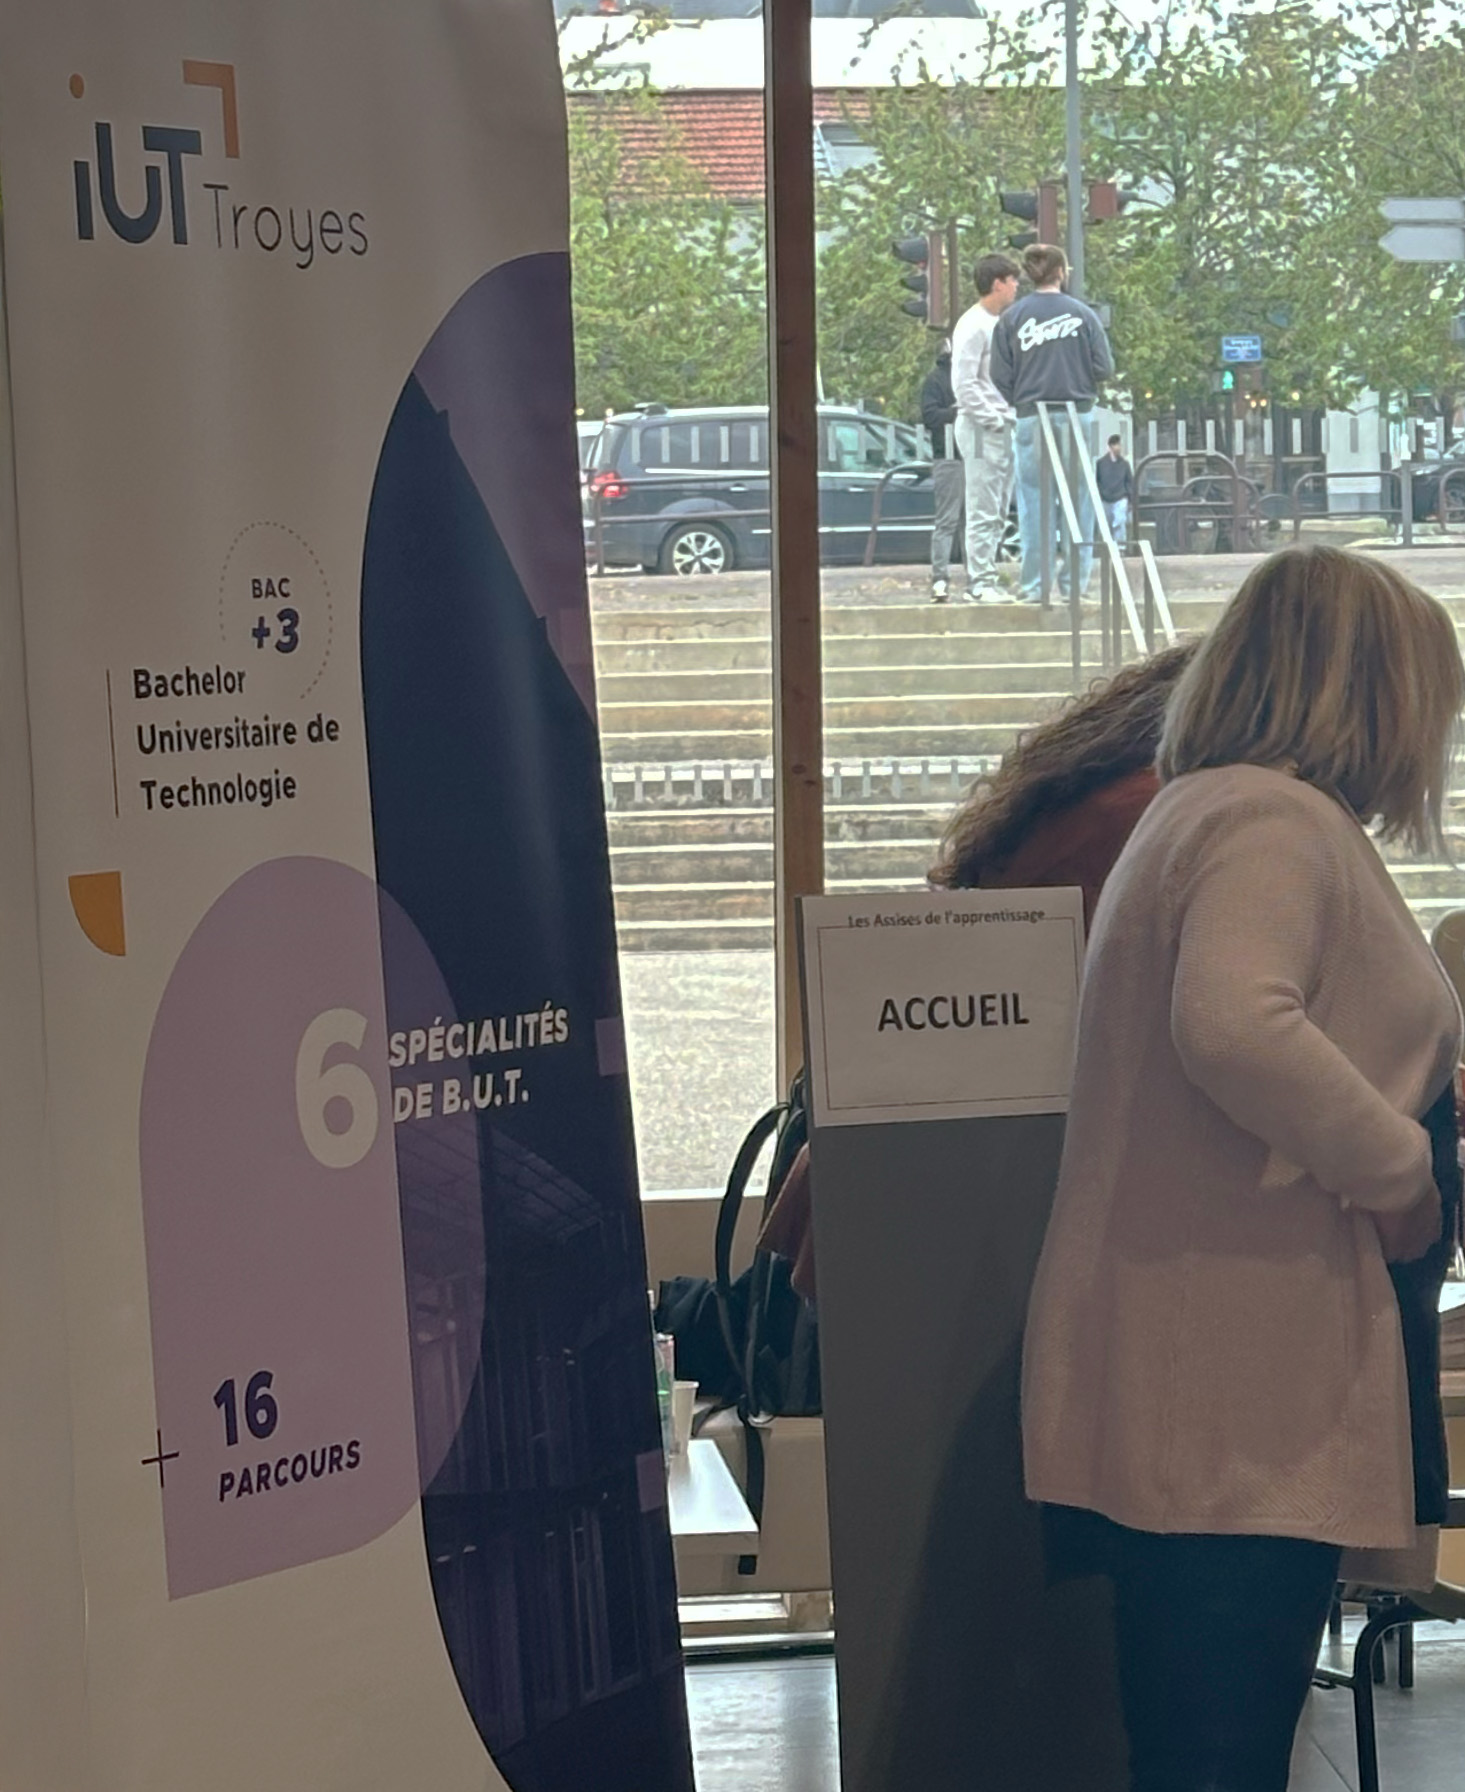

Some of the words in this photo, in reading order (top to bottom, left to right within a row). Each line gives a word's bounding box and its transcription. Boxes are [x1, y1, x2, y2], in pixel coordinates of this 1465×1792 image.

[203, 183, 369, 270] Troyes
[251, 577, 291, 599] BAC
[251, 607, 300, 655] +3
[133, 664, 247, 700] Bachelor
[136, 715, 298, 756] Universitaire
[306, 712, 340, 743] de
[139, 769, 298, 811] Technologie
[848, 913, 870, 929] Les
[873, 912, 922, 927] Assises
[925, 910, 942, 925] de
[945, 907, 1046, 926] l'apprentissage
[388, 1001, 570, 1068] SPÉCIALITÉS
[877, 992, 1030, 1033] ACCUEIL
[295, 1007, 379, 1169] 6
[393, 1082, 434, 1124] DE
[442, 1068, 530, 1116] B.U.T.
[212, 1369, 280, 1448] 16
[218, 1438, 362, 1504] PARCOURS
